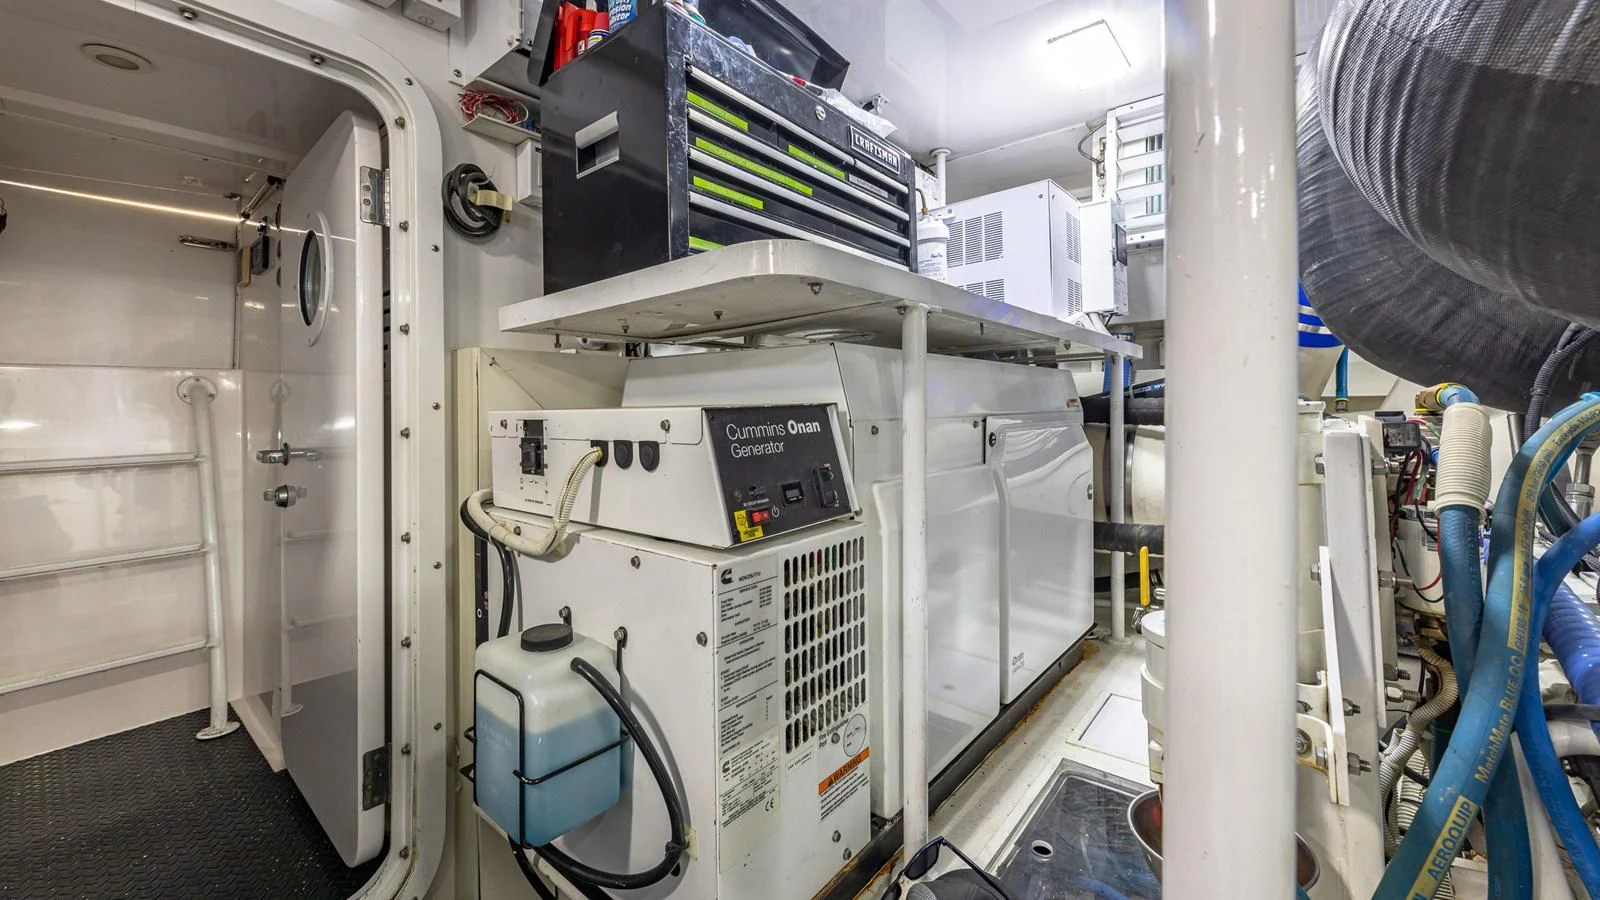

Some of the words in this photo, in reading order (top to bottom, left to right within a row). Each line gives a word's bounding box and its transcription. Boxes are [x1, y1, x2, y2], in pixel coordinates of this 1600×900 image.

[854, 133, 898, 168] CRAFTSMAN
[726, 422, 786, 440] Cummins
[787, 419, 821, 435] Onan
[730, 441, 785, 458] Generator
[1500, 677, 1519, 712] BLUE
[819, 739, 828, 749] Port
[831, 754, 862, 783] WARNING
[1427, 801, 1473, 881] AEROQUIP
